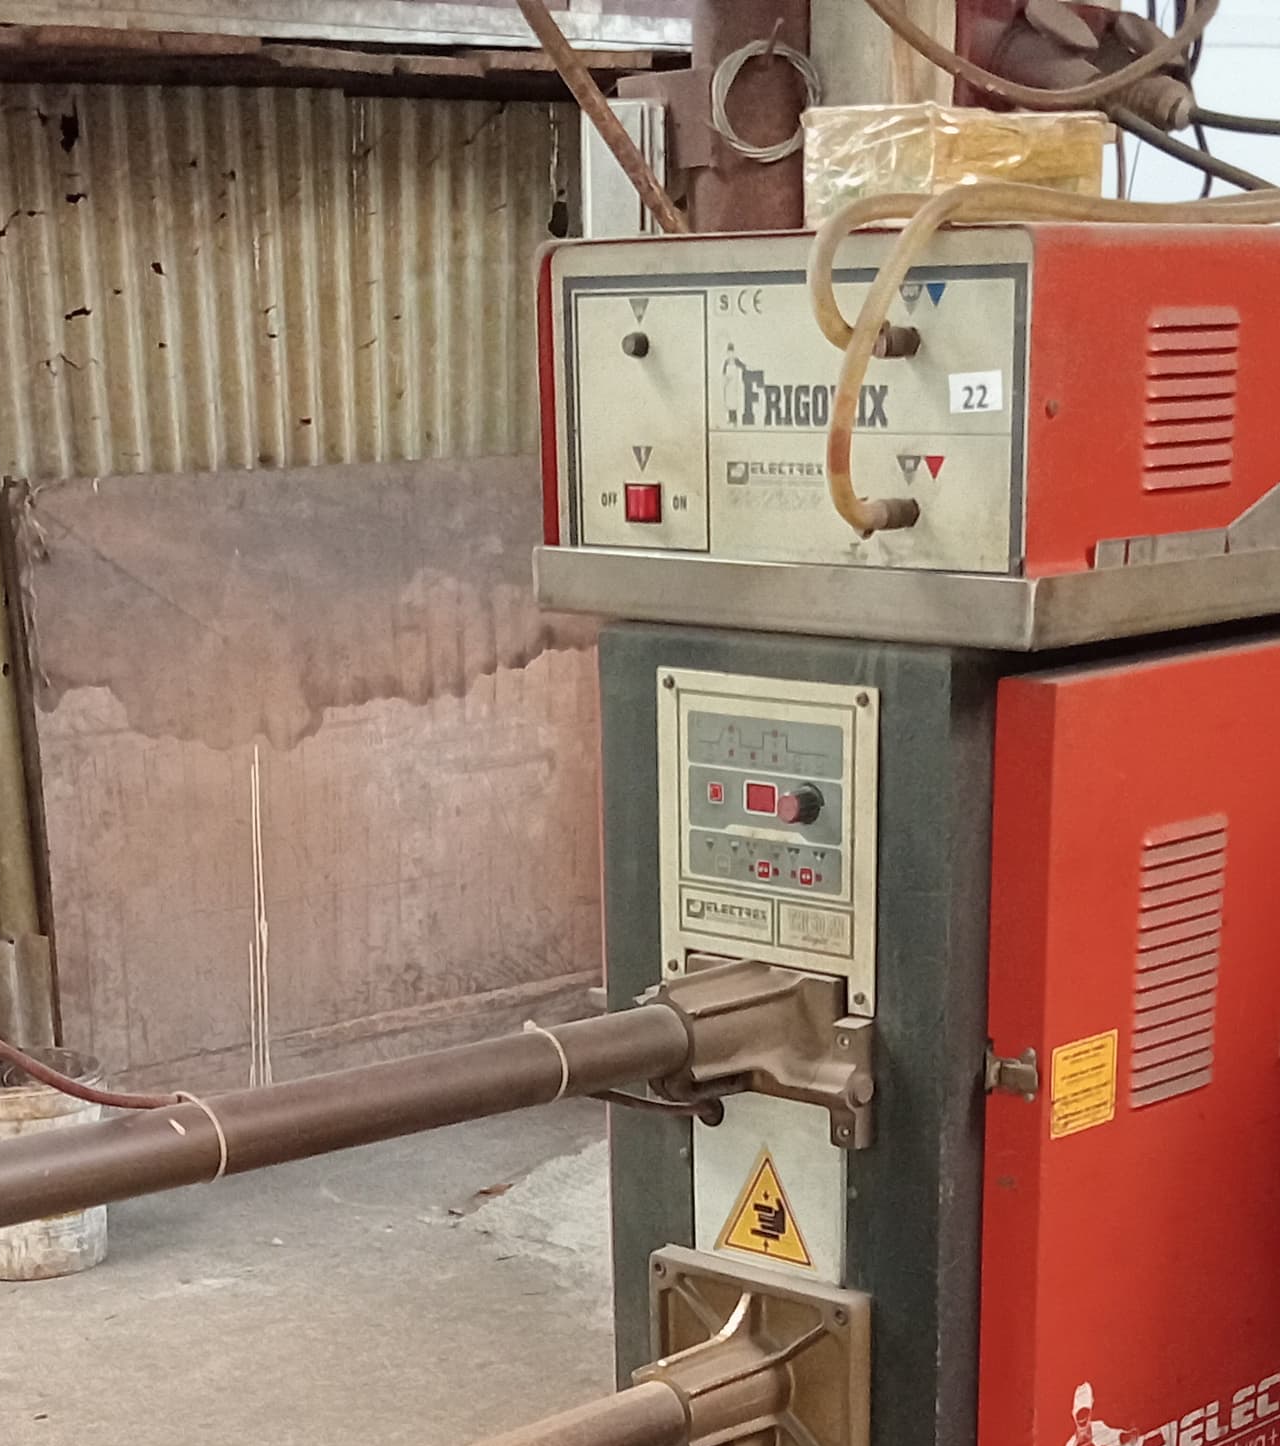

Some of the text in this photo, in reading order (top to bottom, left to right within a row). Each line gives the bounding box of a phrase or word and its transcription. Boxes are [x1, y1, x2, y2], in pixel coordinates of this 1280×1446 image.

[742, 370, 888, 427] FRIGOIX
[962, 384, 989, 410] 22
[601, 492, 617, 507] OFF
[672, 495, 688, 511] ON
[706, 902, 767, 921] ELECTREX
